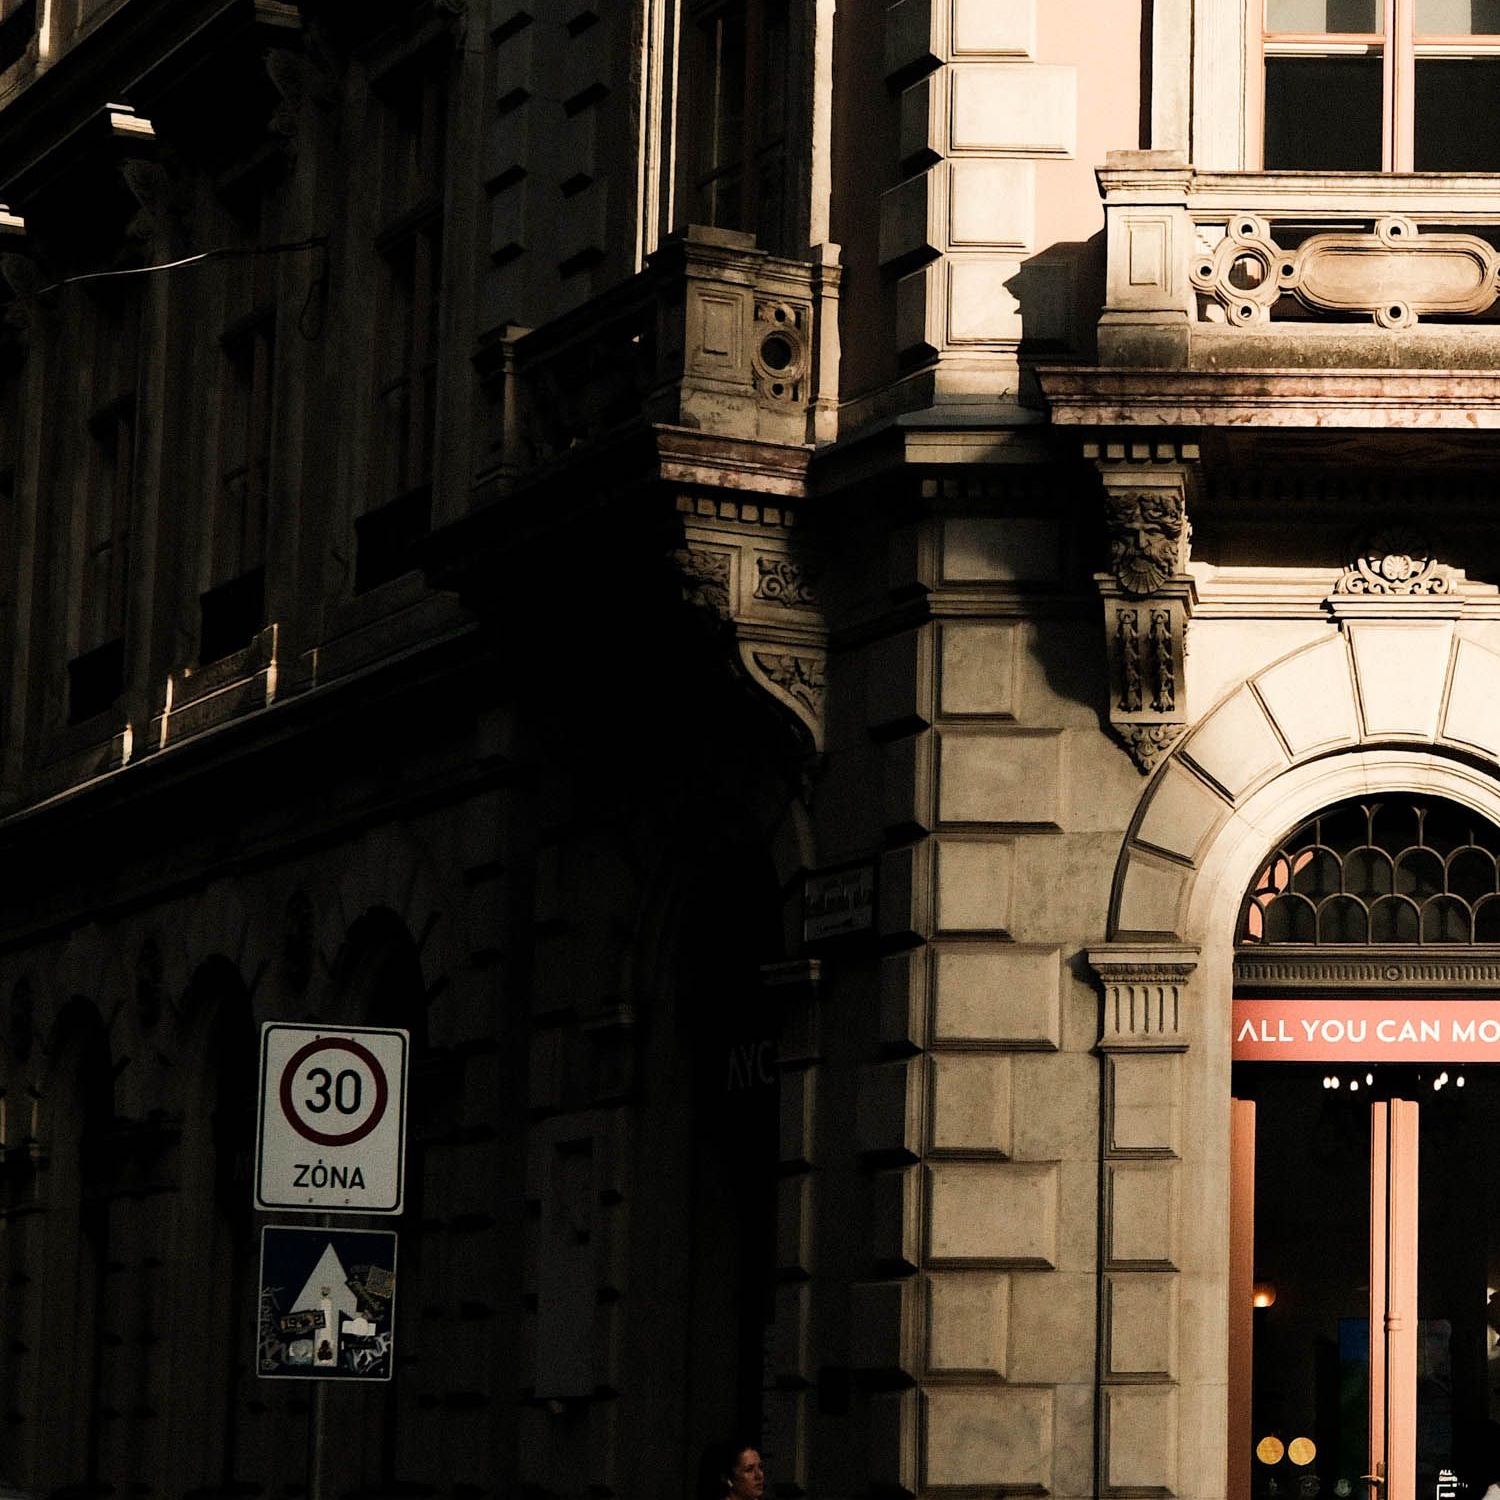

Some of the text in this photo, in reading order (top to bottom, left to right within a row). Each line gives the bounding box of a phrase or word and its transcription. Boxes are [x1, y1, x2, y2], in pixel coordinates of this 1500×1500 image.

[1237, 1019, 1294, 1043] ALL
[1301, 1019, 1367, 1043] YOU
[1376, 1019, 1440, 1043] CAN
[305, 1067, 361, 1115] 30
[292, 1158, 367, 1191] ZÓNA
